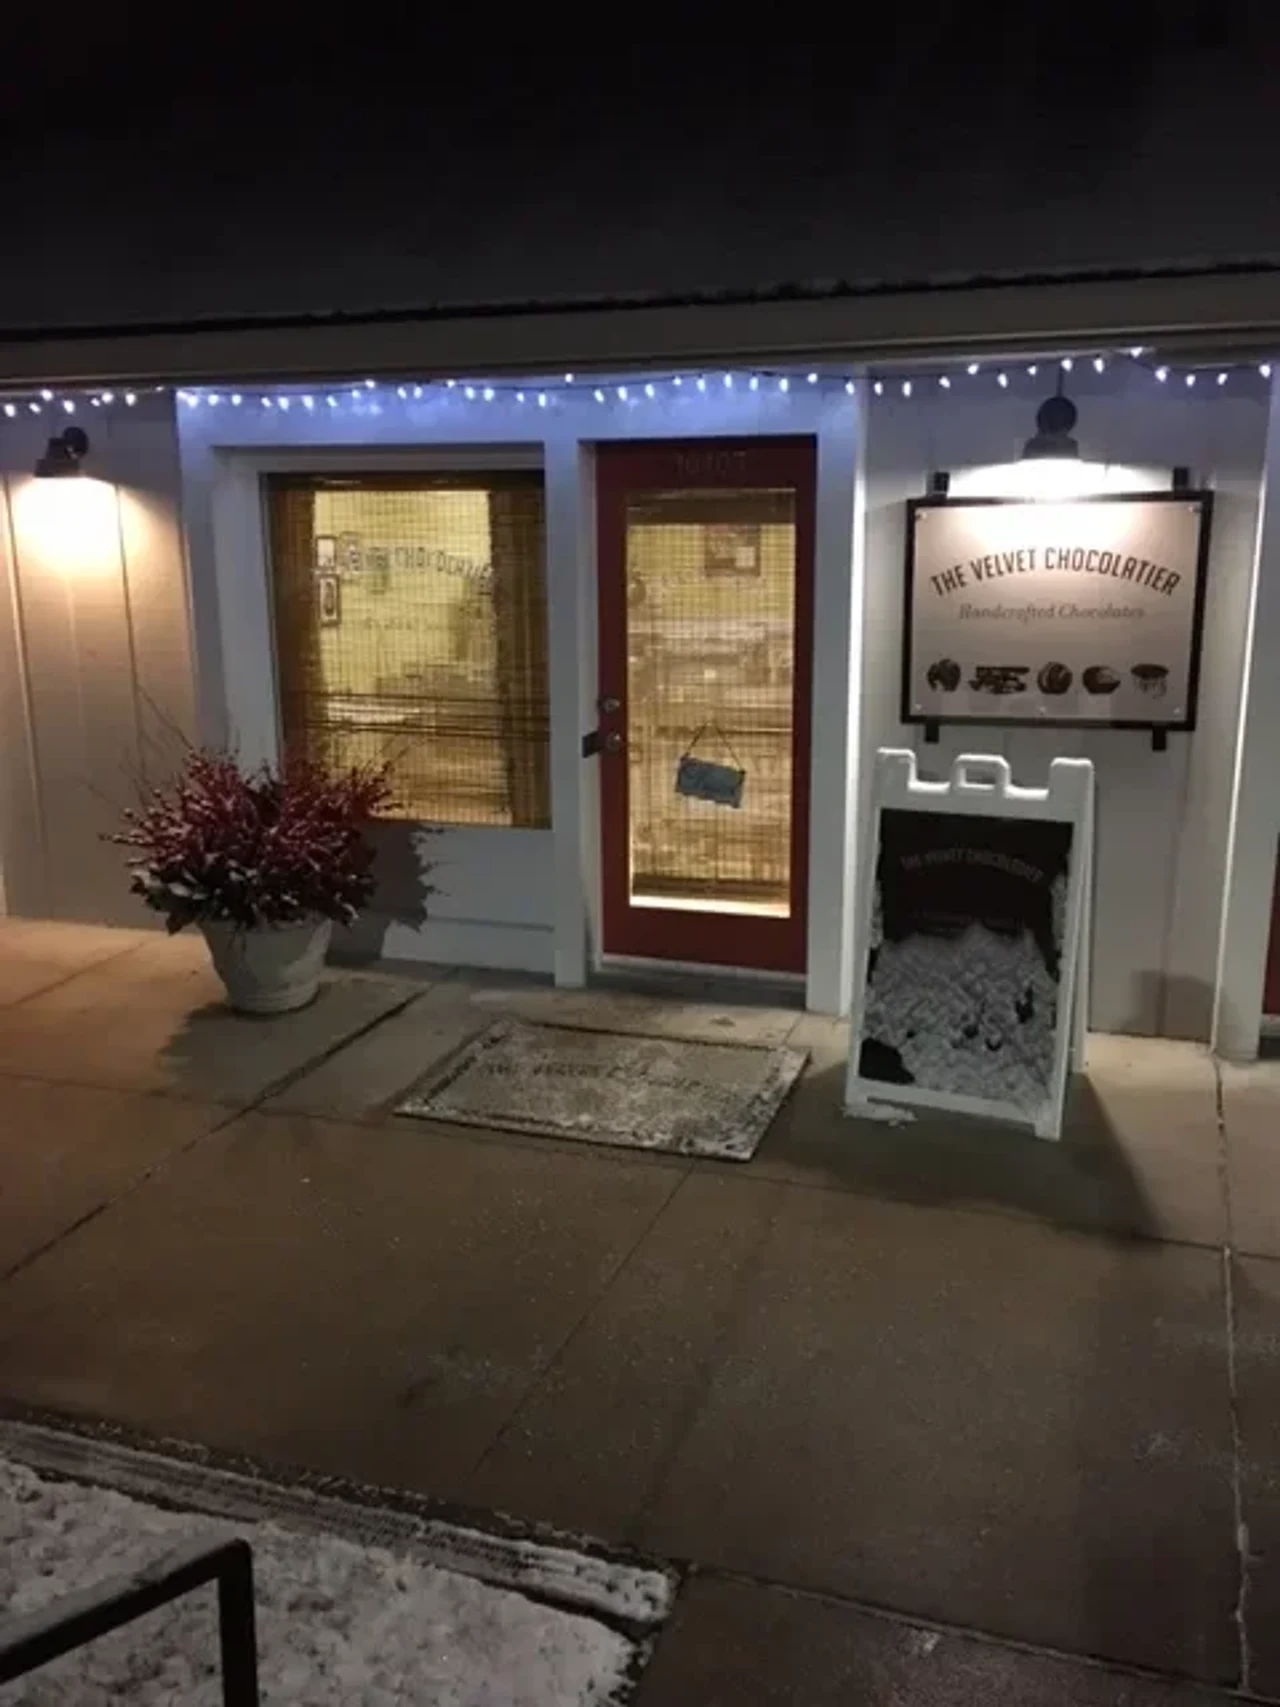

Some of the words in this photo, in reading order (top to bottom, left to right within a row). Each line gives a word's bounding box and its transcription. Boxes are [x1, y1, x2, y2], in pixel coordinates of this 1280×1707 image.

[931, 565, 966, 597] THE
[971, 549, 1036, 581] VELVET
[1045, 547, 1181, 596] CHOCOLATIER
[959, 603, 1054, 624] Handcrafted
[1058, 603, 1145, 621] Chocolates
